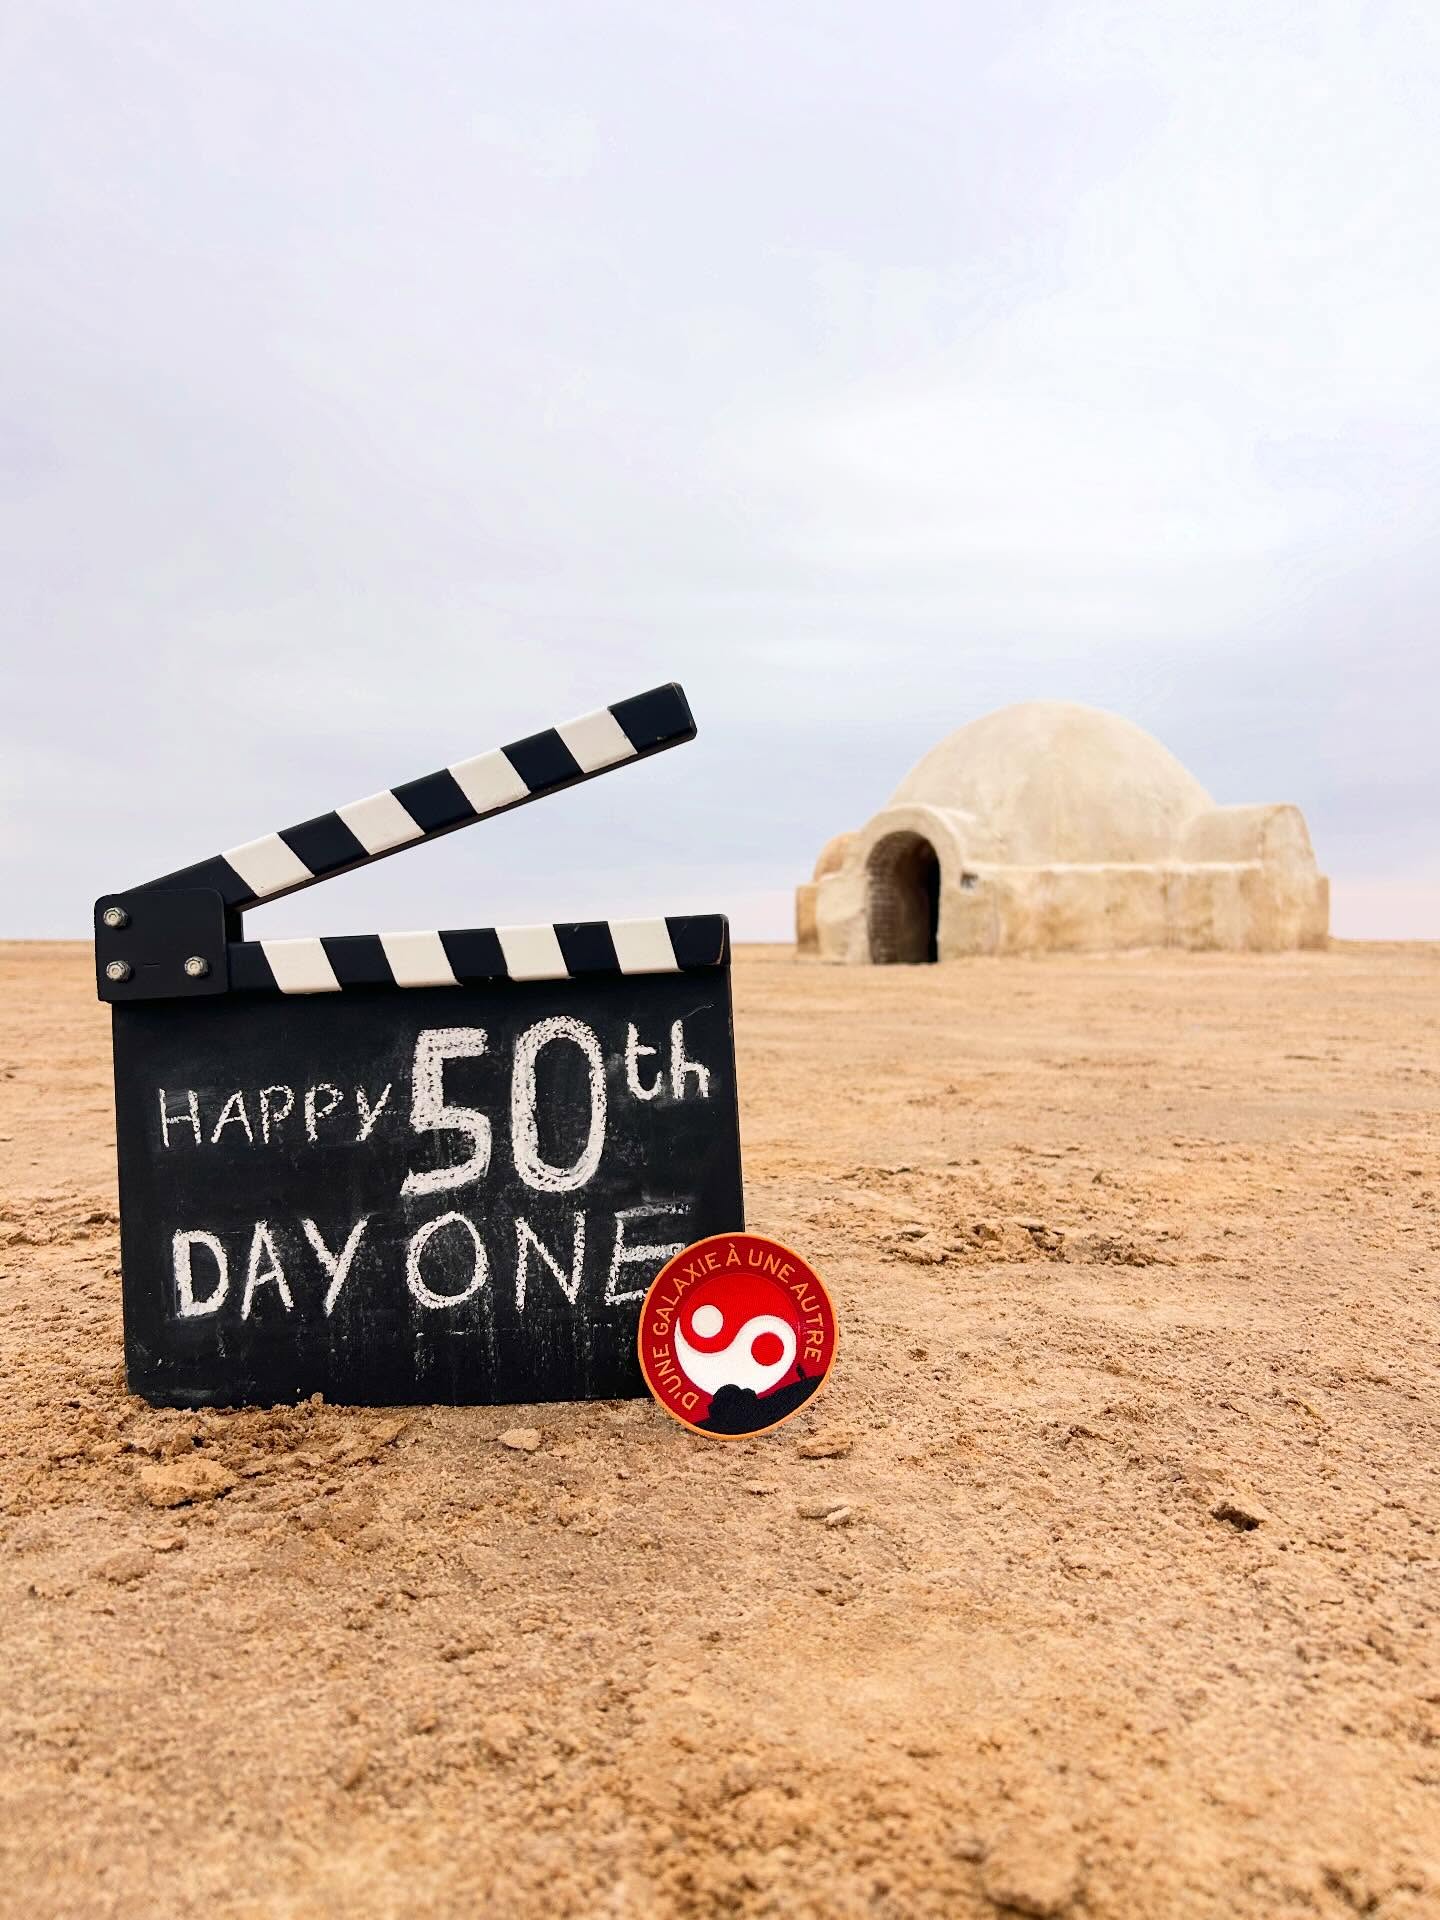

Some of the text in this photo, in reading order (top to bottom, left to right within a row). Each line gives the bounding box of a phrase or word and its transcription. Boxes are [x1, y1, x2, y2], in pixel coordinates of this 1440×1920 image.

[158, 1015, 711, 1197] HAPPY 50th
[172, 1203, 692, 1320] DAY ONE
[653, 1243, 824, 1410] D'UNE GALAXIE À UNE AUTRE
